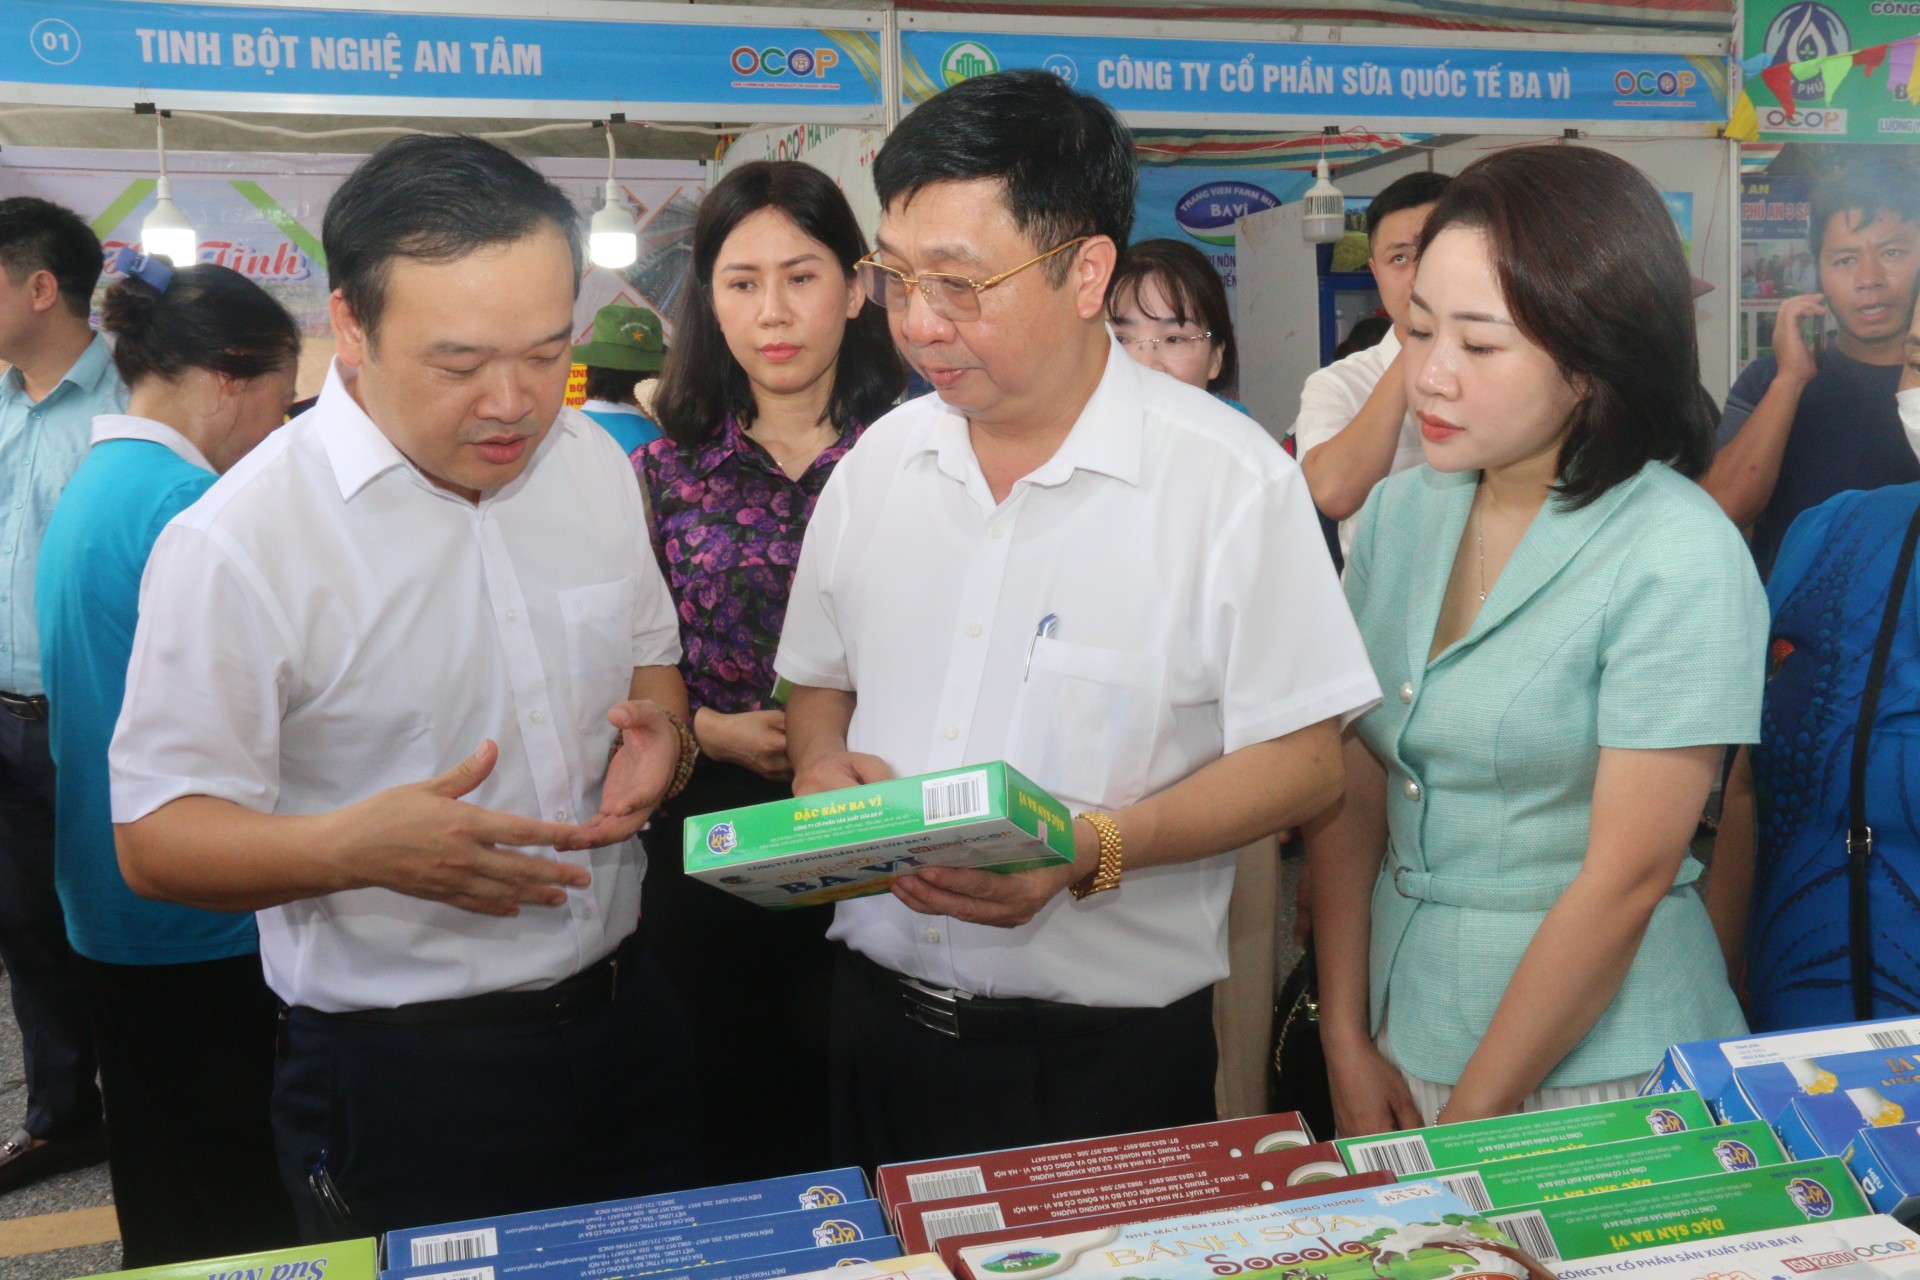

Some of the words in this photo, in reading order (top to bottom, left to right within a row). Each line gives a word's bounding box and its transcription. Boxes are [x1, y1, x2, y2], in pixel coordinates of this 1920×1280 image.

[42, 32, 70, 52] 01
[136, 28, 220, 65] TINH
[233, 27, 299, 75] BỘT
[311, 32, 402, 79] NGHỆ
[414, 40, 461, 74] AN
[470, 36, 542, 76] TÂM
[731, 46, 838, 78] OCOP
[1099, 55, 1172, 90] CÔNG
[1181, 63, 1212, 91] TY
[1219, 53, 1256, 92] CỔ
[1264, 57, 1334, 94] PHẦN
[1342, 63, 1393, 96] SỮA
[1400, 61, 1466, 99] QUỐC
[1473, 62, 1502, 99] TẾ
[1509, 72, 1545, 99] BA
[1549, 64, 1571, 100] VÌ
[1614, 69, 1696, 97] OCOP
[1180, 190, 1209, 212] TRANG
[1233, 186, 1259, 200] FARM
[792, 806, 819, 822] ĐẶC
[820, 800, 846, 815] SẢN
[848, 800, 865, 810] BA
[867, 795, 882, 807] VÌ
[775, 875, 858, 894] BA
[1184, 1179, 1209, 1189] TRUNG
[1214, 1177, 1218, 1185] 3
[1219, 1175, 1235, 1184] KHU
[1052, 1200, 1063, 1208] BA
[1127, 1198, 1137, 1206] SX
[1690, 1207, 1698, 1215] TY
[1698, 1204, 1717, 1214] CÔNG
[1608, 1219, 1618, 1228] BA
[1655, 1223, 1690, 1244] SẢN
[1689, 1215, 1725, 1237] ĐẶC
[1103, 1231, 1252, 1268] BÁNH
[1259, 1214, 1366, 1244] SỮA
[1609, 1233, 1630, 1251] VÌ
[1629, 1229, 1655, 1244] BA
[1205, 1236, 1373, 1276] Socola
[1556, 1265, 1595, 1280] CÔNG
[1598, 1262, 1612, 1274] TY
[1616, 1259, 1635, 1272] CỔ
[1636, 1253, 1675, 1268] PHẦN
[1676, 1249, 1703, 1262] SẢN
[1705, 1243, 1738, 1258] XUẤT
[1741, 1239, 1768, 1253] SỮA
[1769, 1236, 1786, 1248] BA
[1785, 1233, 1803, 1246] VÌ
[1787, 1259, 1812, 1271] ISO
[1811, 1252, 1858, 1267] 22000
[1853, 1239, 1917, 1257] OCOP
